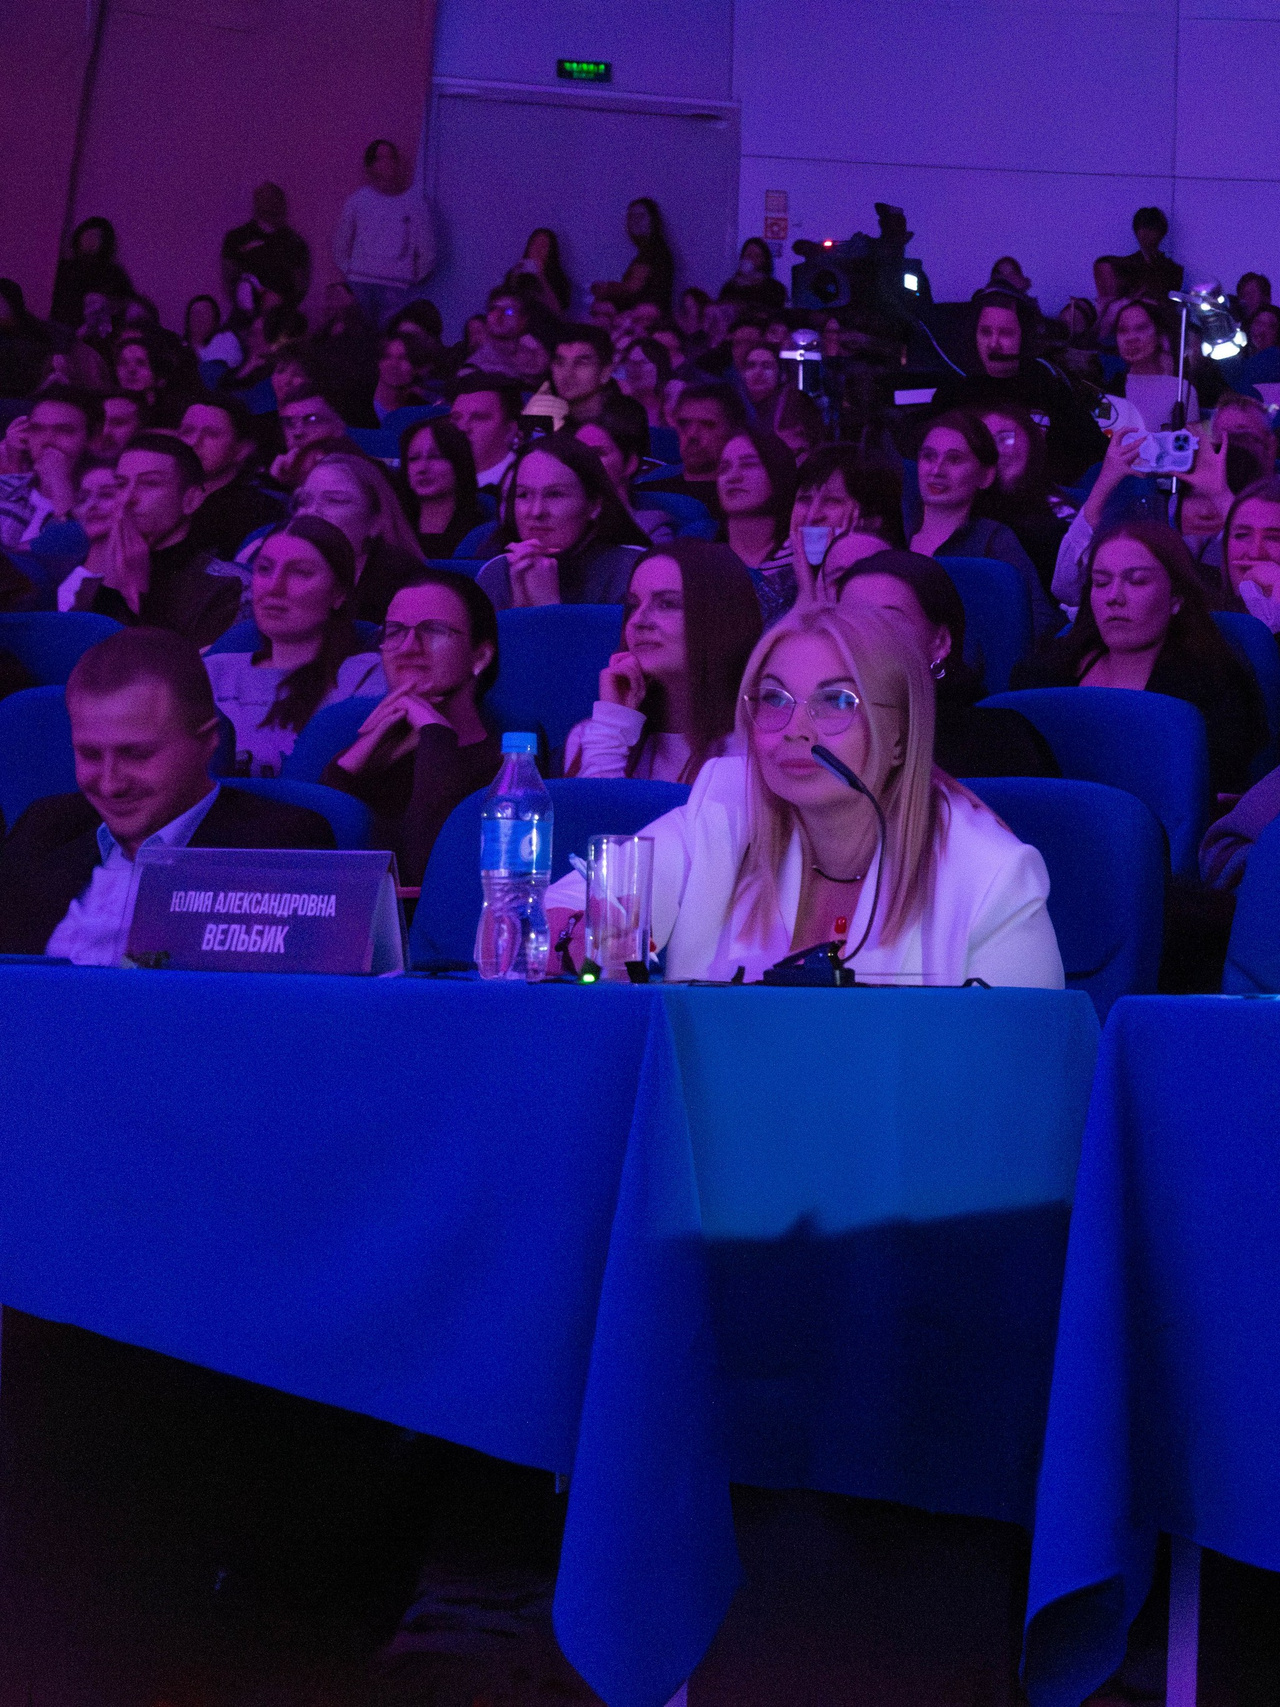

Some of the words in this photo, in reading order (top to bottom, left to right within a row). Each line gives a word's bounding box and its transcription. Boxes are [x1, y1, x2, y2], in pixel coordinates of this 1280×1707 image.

[170, 891, 213, 912] ЮЛИЯ
[214, 891, 336, 917] АЛЕКСАНДРОВНА
[202, 924, 289, 953] ВЕЛЬБИК
